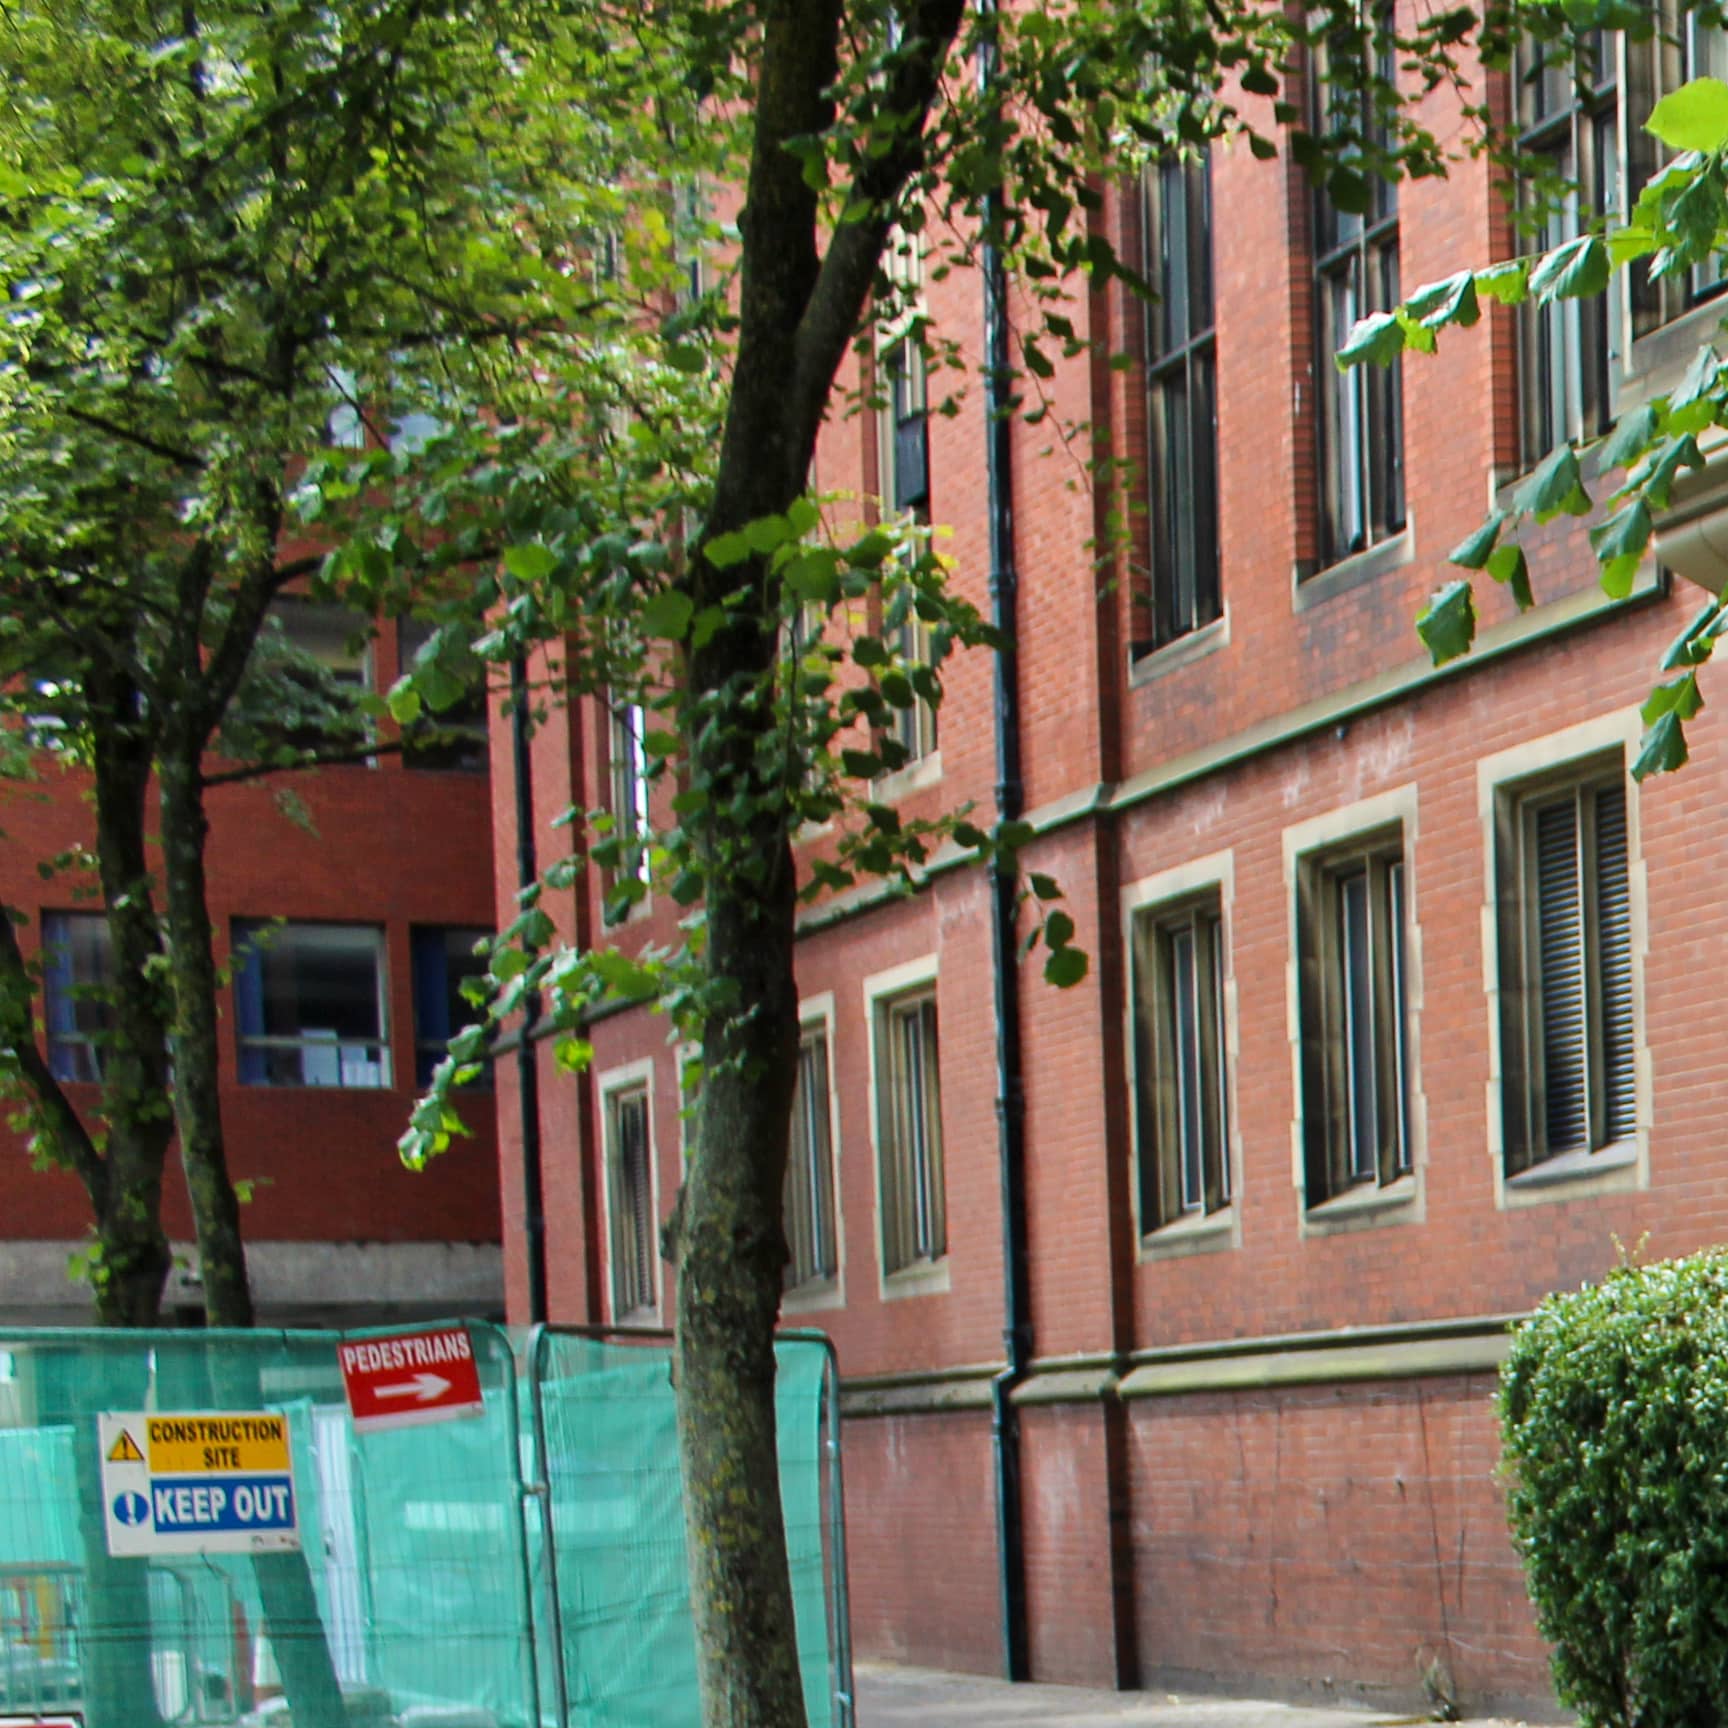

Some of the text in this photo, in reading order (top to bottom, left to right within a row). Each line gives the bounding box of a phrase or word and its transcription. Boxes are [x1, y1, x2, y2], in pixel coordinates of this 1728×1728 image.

[342, 1331, 471, 1374] PEDESTRIANS
[150, 1419, 282, 1444] CONSTRUCTION
[203, 1446, 241, 1468] SITE
[154, 1485, 290, 1525] KEEP OUT
